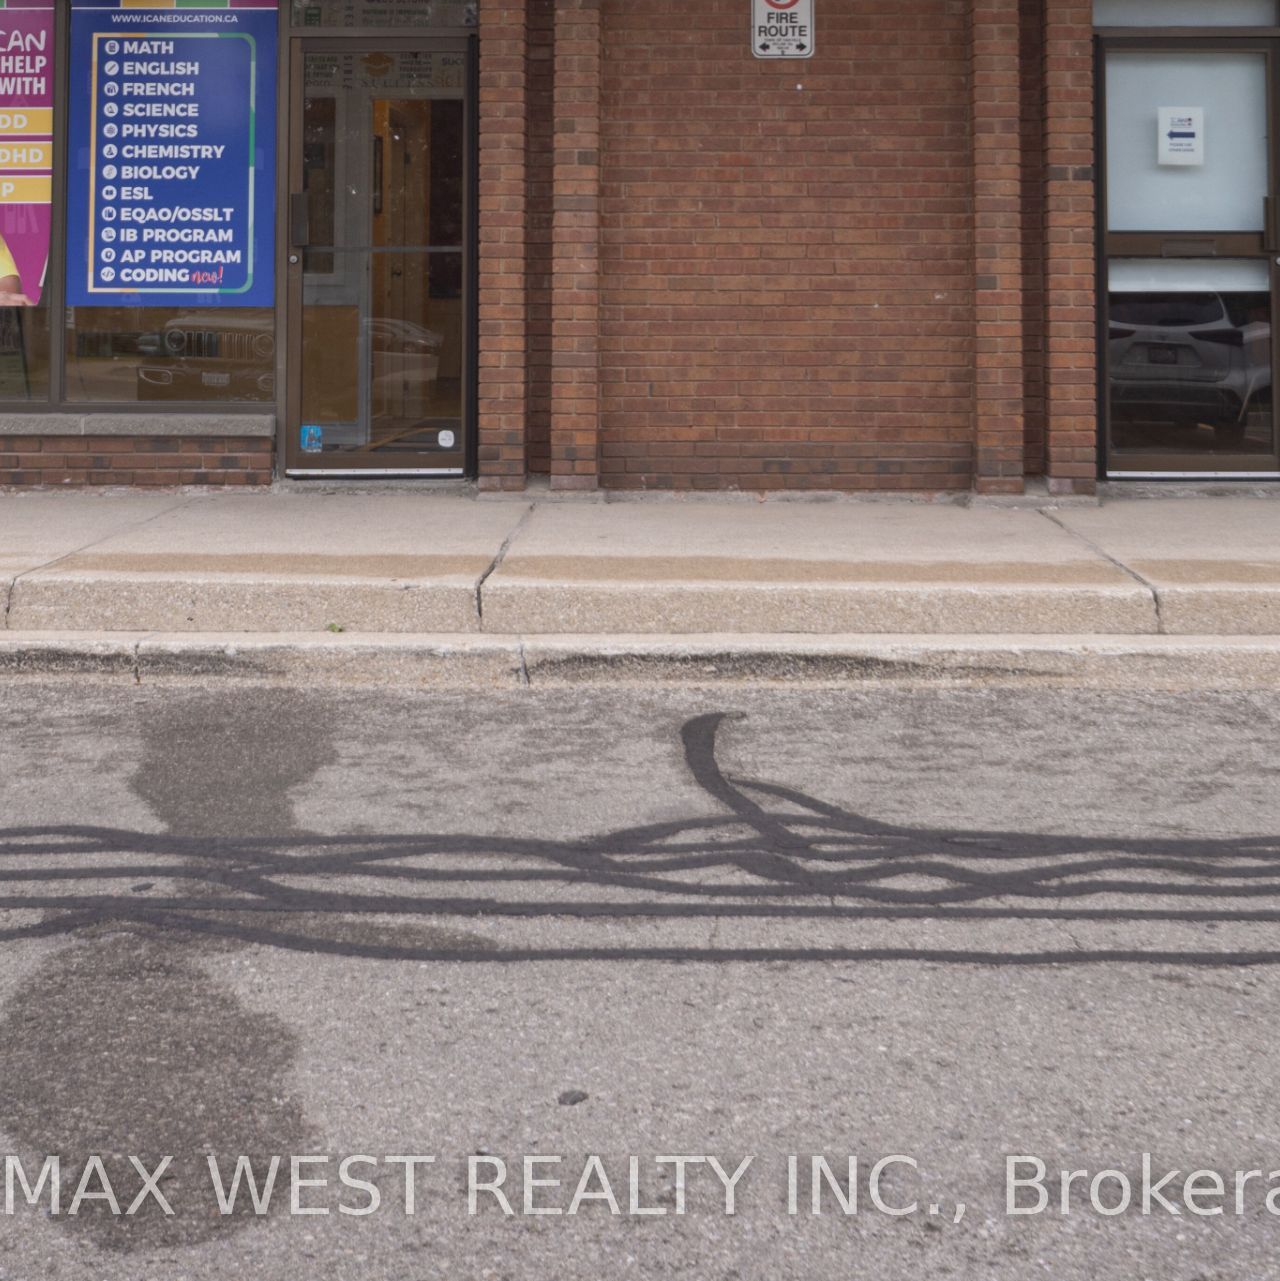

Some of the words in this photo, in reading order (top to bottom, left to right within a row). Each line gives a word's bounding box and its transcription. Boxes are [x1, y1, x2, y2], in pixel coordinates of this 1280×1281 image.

[112, 15, 238, 23] WWW.ICANEDUCATION.CA
[767, 12, 798, 23] FIRE
[758, 26, 807, 36] ROUTE
[124, 41, 174, 54] MATH
[1, 56, 47, 73] HELP
[123, 62, 199, 75] ENGLISH
[123, 83, 194, 95] FRENCH
[123, 104, 199, 116] SCIENCE
[122, 124, 198, 137] PHYSICS
[122, 145, 225, 158] CHEMISTRY
[121, 166, 200, 180] BIOLOGY
[121, 187, 153, 200] ESL
[120, 207, 234, 223] EQAO/OSSLT
[120, 229, 137, 242] IB
[143, 229, 233, 242] PROGRAM
[120, 250, 146, 263] AP
[151, 250, 241, 263] PROGRAM
[120, 269, 189, 282] CODING
